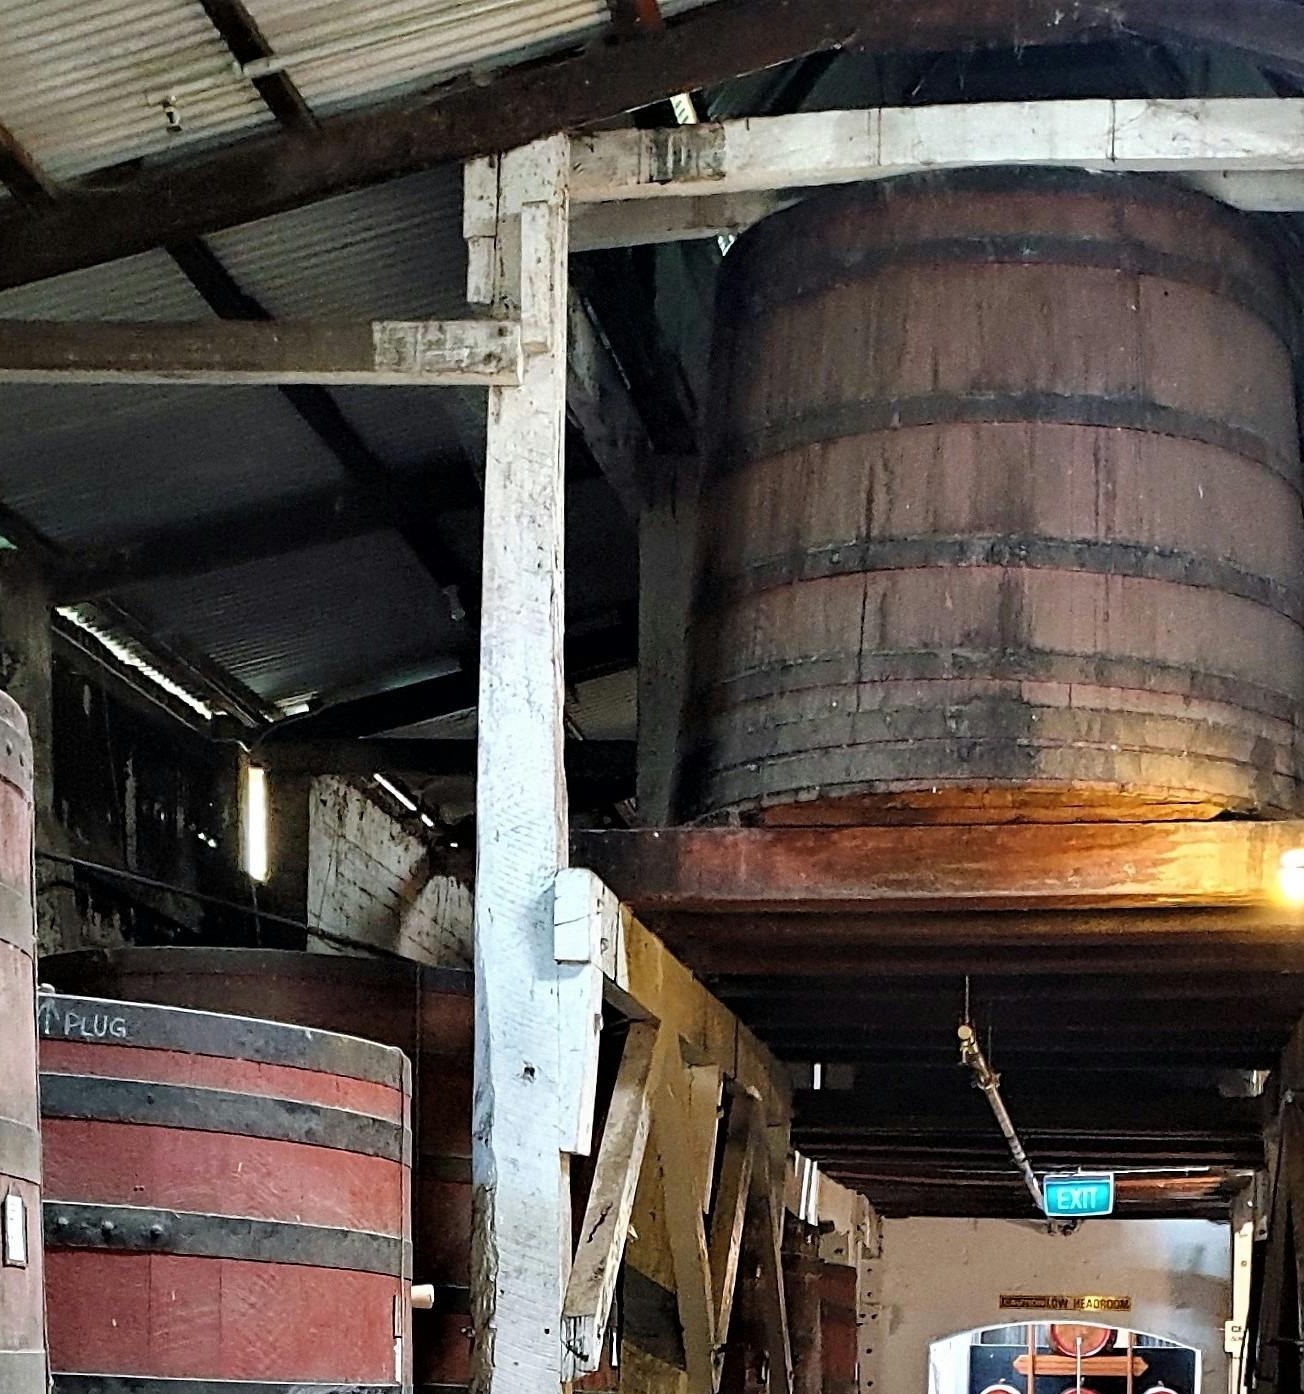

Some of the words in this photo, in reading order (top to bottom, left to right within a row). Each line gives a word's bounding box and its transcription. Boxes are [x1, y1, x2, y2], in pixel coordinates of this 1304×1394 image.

[64, 1012, 127, 1037] PLUG
[1057, 1187, 1098, 1210] EXIT
[1073, 1298, 1130, 1311] HEADROOM
